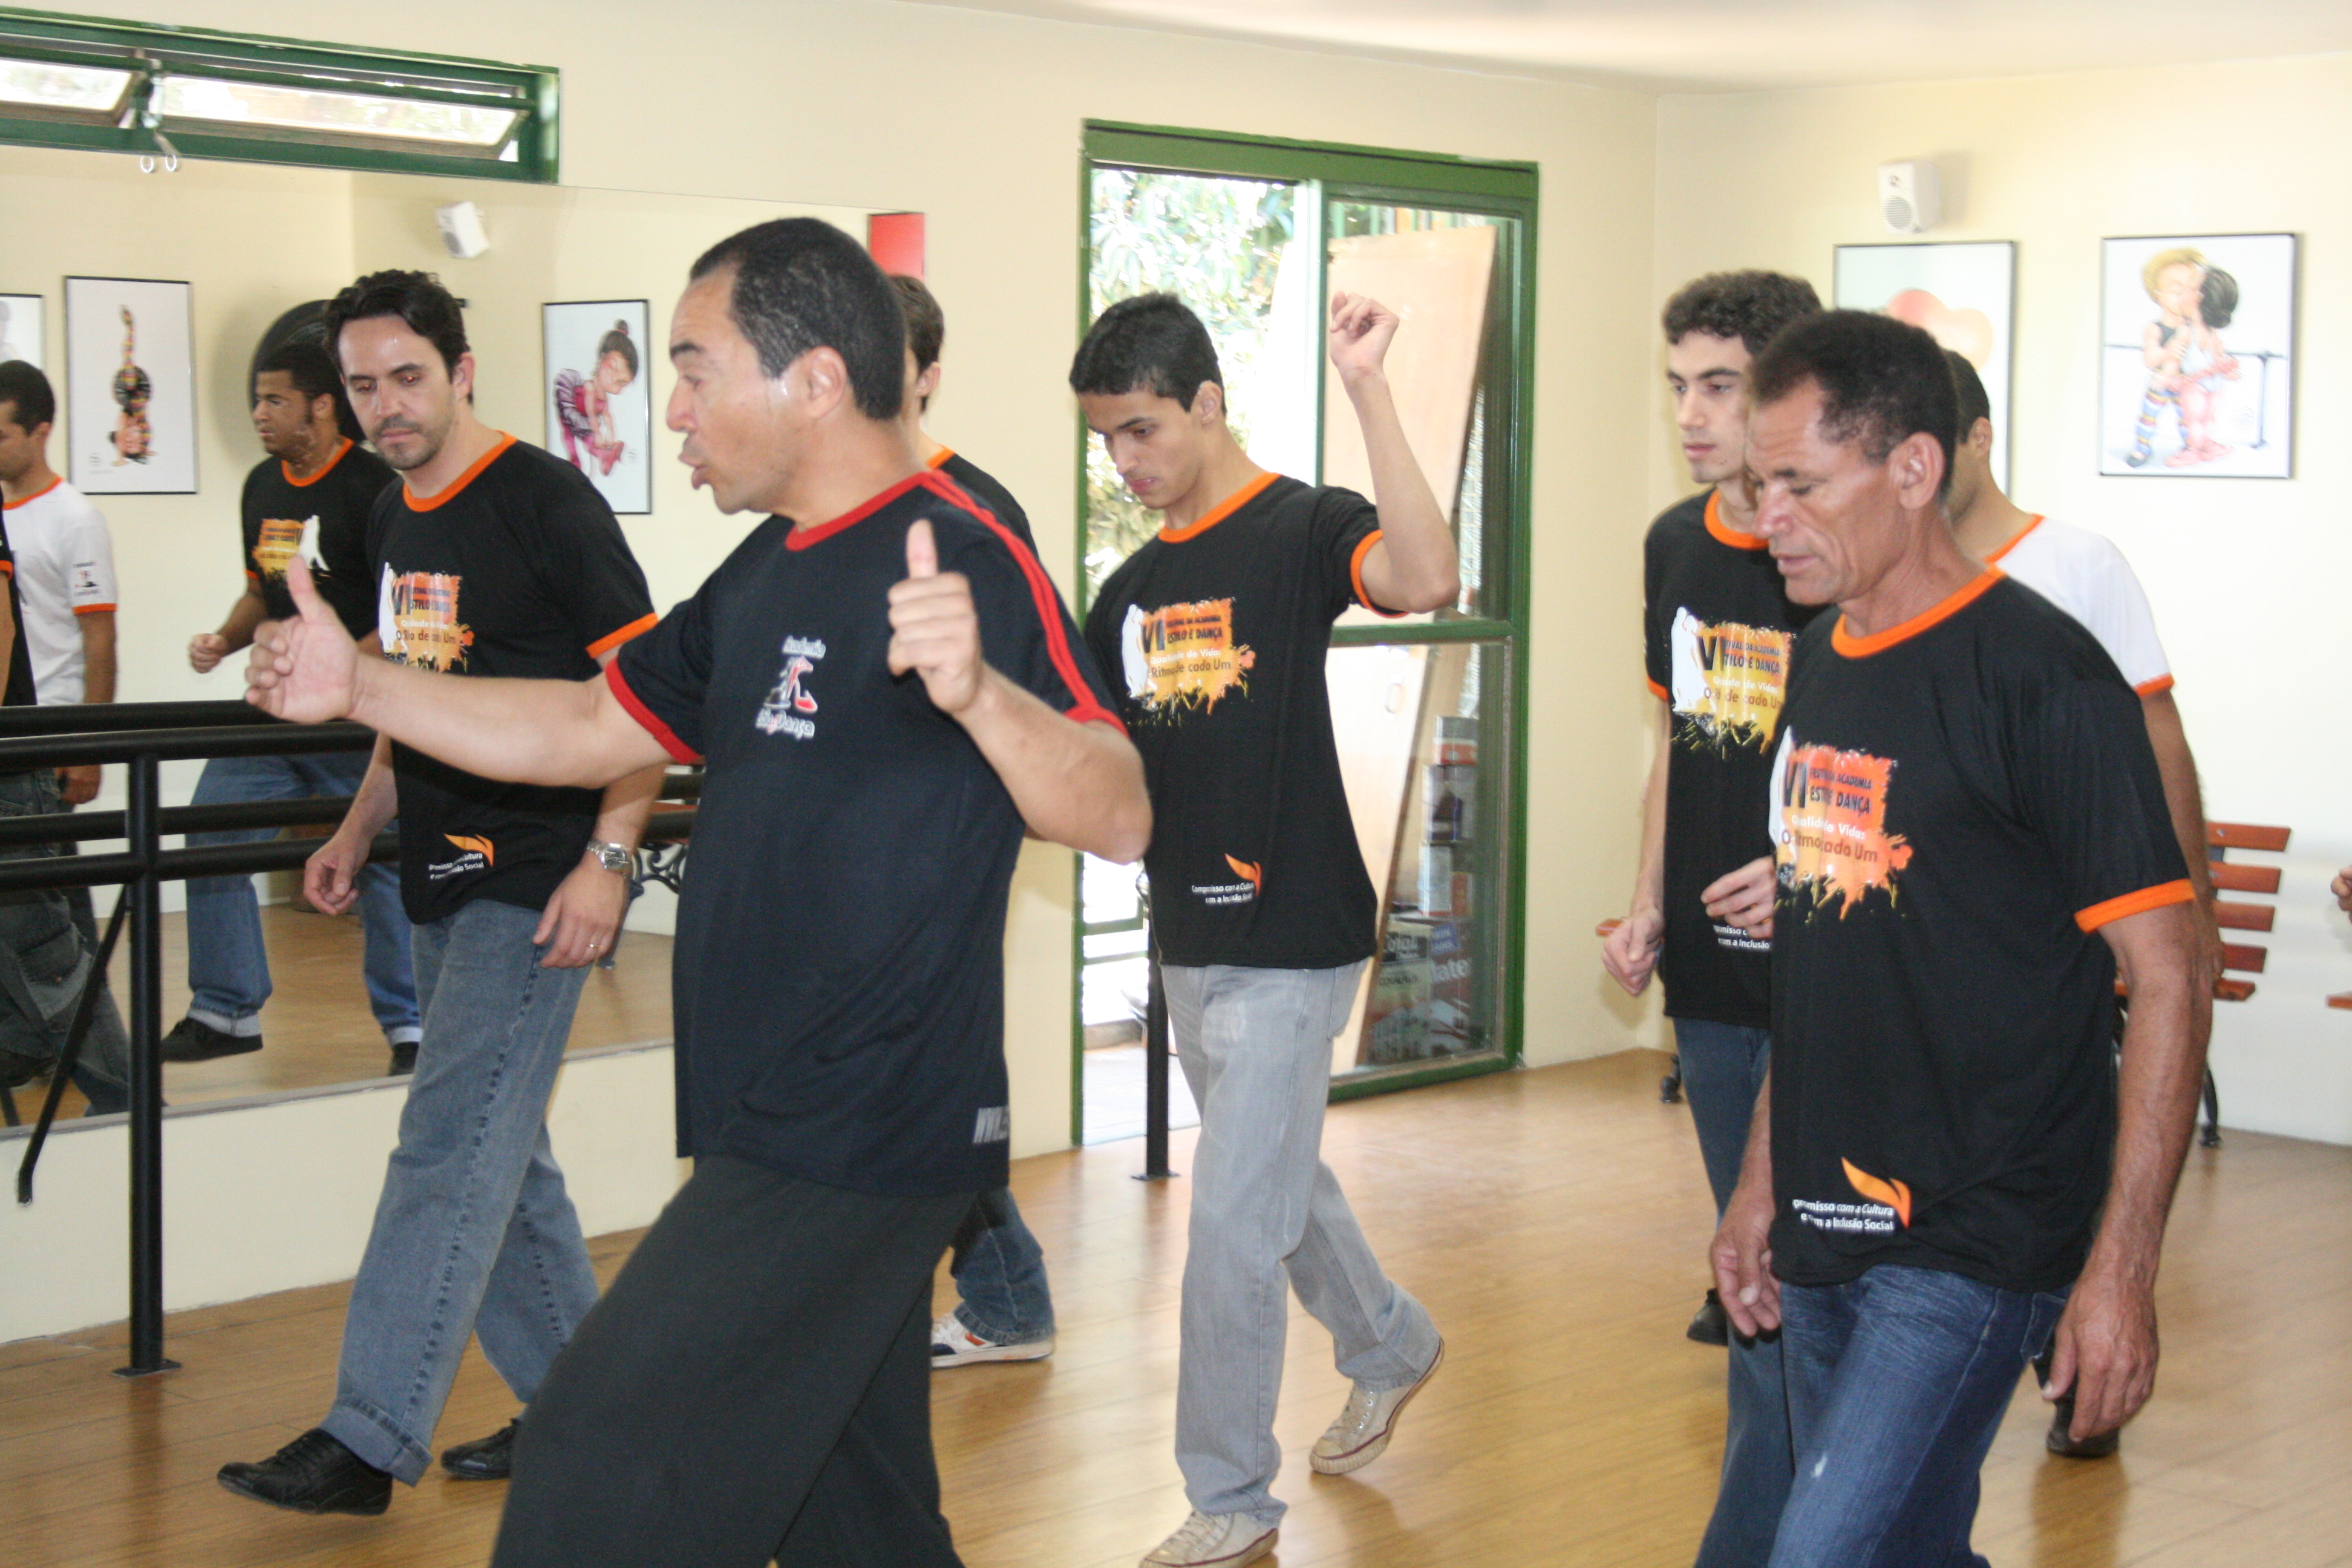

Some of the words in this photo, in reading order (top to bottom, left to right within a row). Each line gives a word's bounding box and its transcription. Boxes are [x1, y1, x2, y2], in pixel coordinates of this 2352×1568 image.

[418, 630, 429, 641] de
[1196, 627, 1222, 642] DANÇA
[1186, 649, 1198, 658] de
[1200, 648, 1221, 657] Vida:
[1188, 658, 1210, 672] cada
[1214, 658, 1230, 670] Um
[1756, 659, 1780, 676] DANÇA
[1743, 679, 1755, 689] de
[1704, 687, 1711, 699] O
[1837, 791, 1870, 817] DANÇA
[1838, 823, 1865, 840] Vida:
[1782, 828, 1791, 845] O
[1855, 843, 1878, 861] Um
[1739, 939, 1770, 949] Inclusão
[1837, 1204, 1854, 1213] com
[1861, 1203, 1893, 1216] Cultura
[1824, 1219, 1831, 1227] a
[1832, 1217, 1862, 1229] Inclusão
[1864, 1218, 1893, 1230] Social
